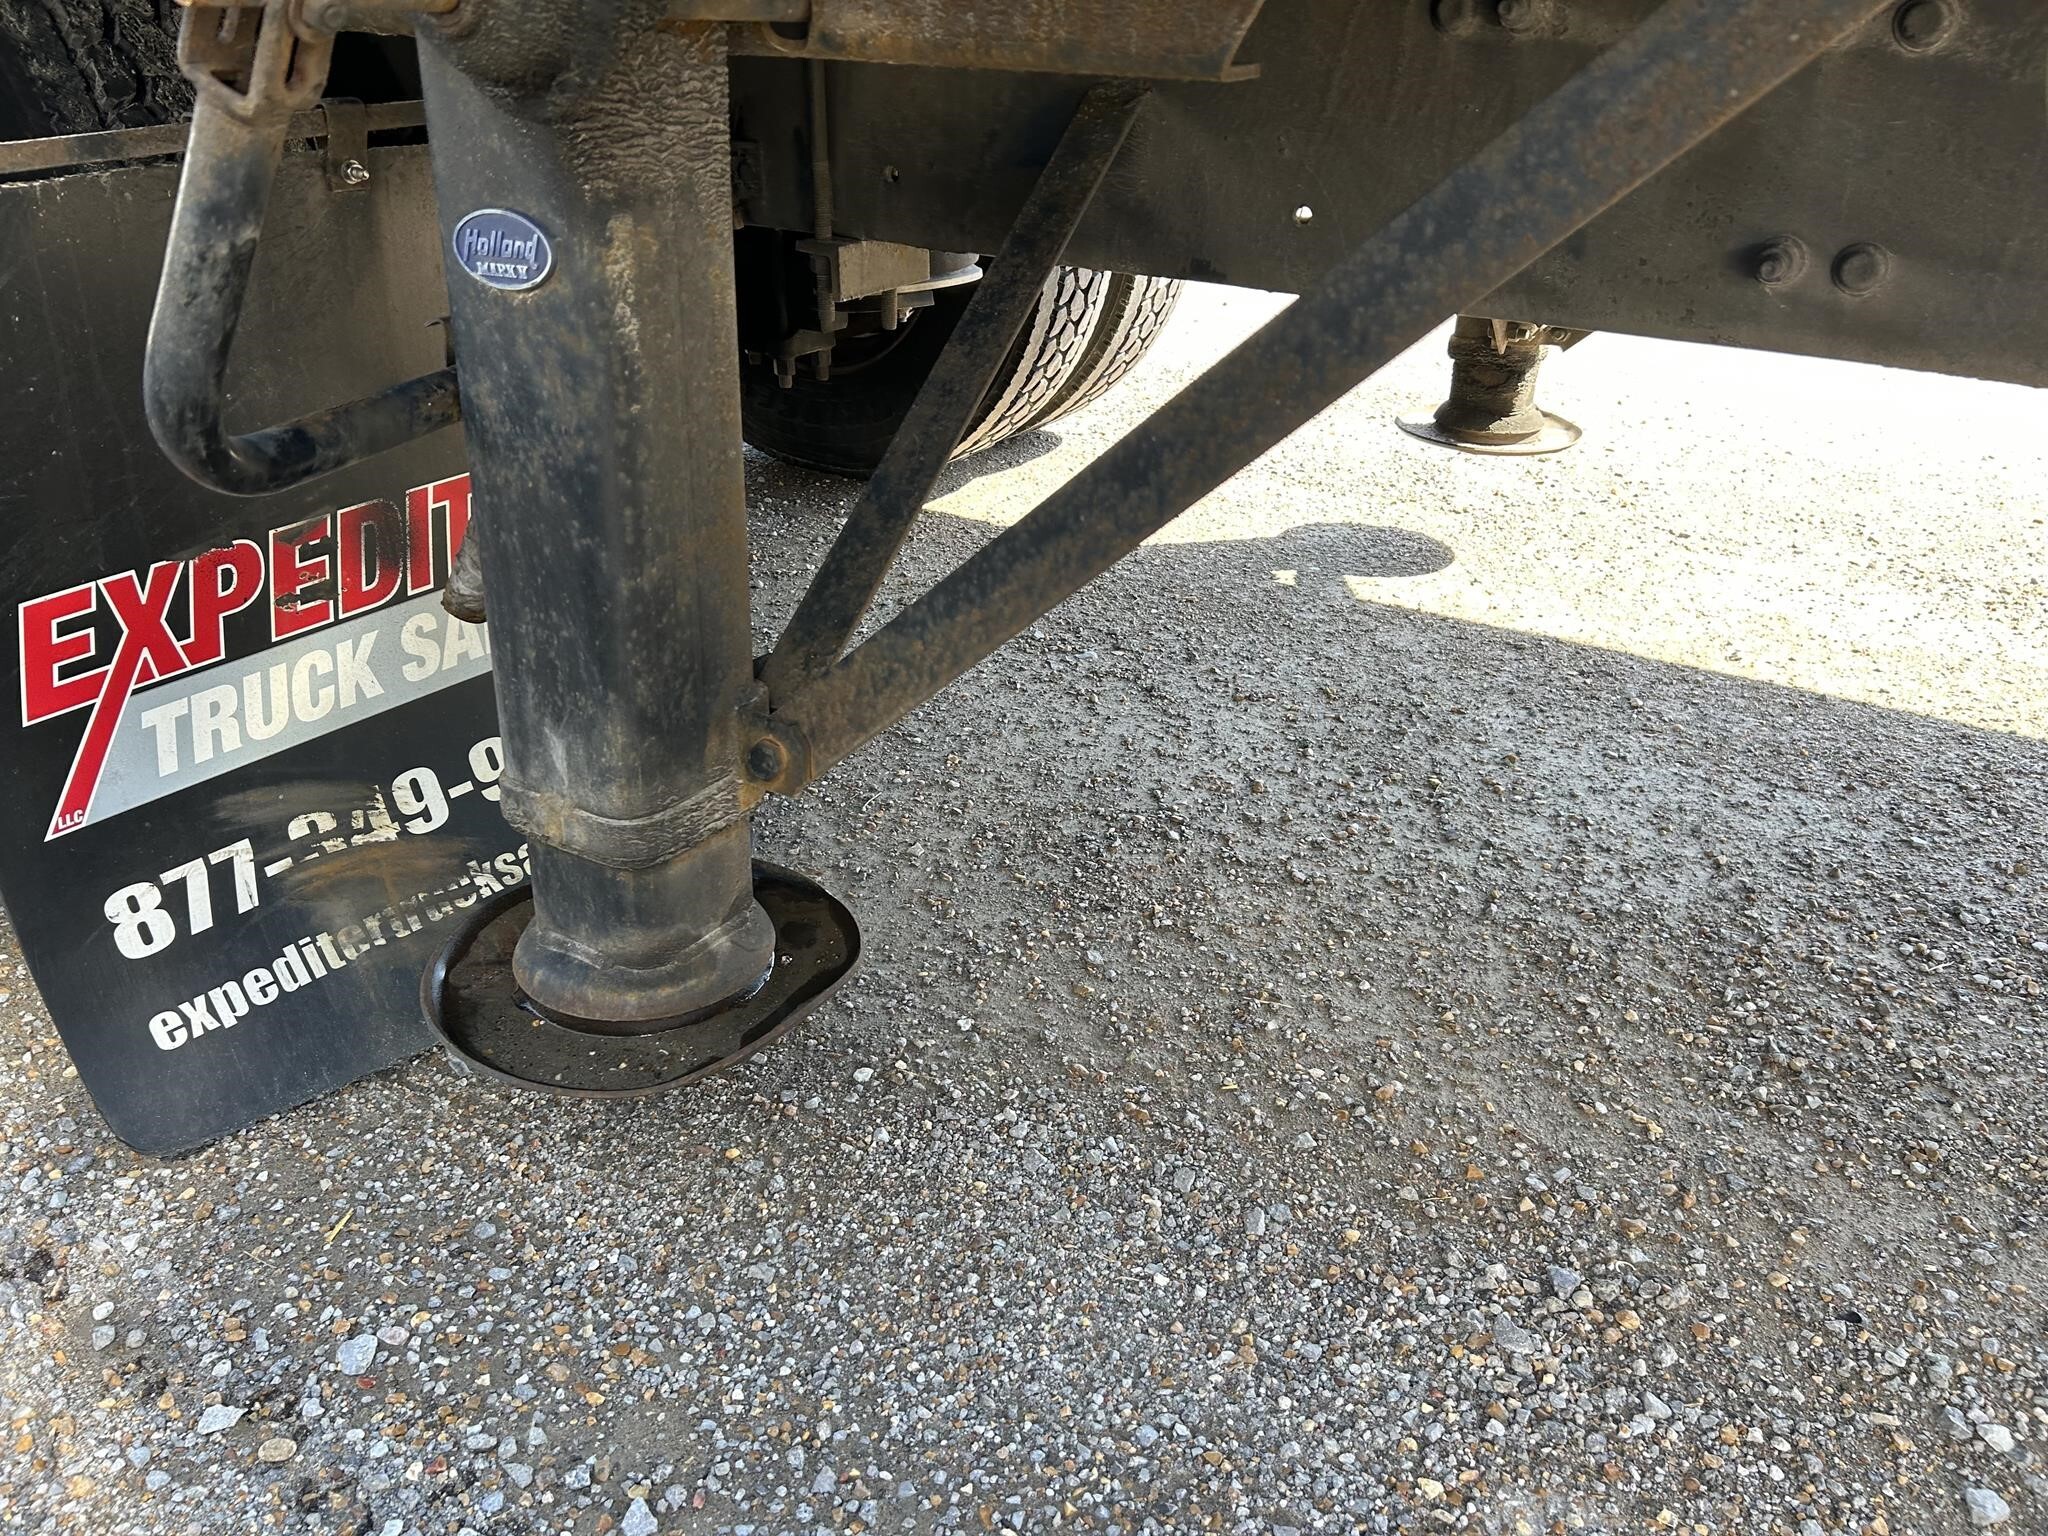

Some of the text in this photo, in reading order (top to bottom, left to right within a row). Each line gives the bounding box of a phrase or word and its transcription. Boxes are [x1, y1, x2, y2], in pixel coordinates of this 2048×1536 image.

[463, 228, 538, 270] Holland
[18, 472, 473, 842] EXPEDIT
[141, 612, 491, 778] TRUCK SA
[57, 809, 84, 830] LLC
